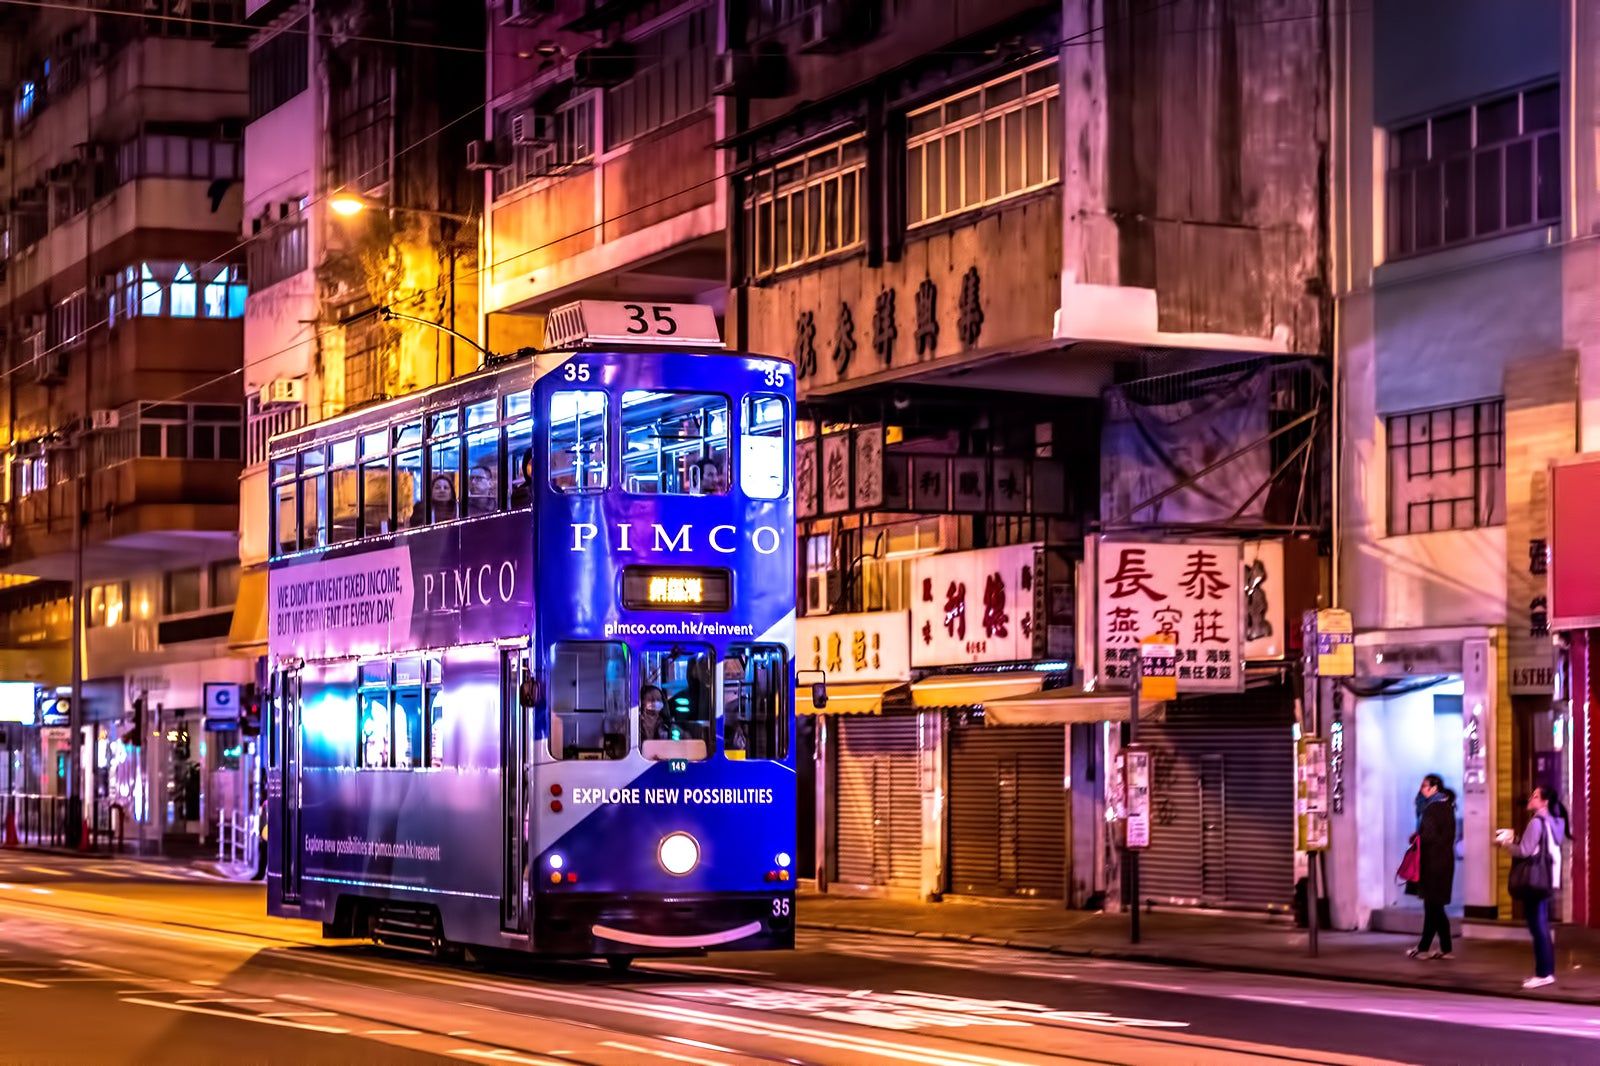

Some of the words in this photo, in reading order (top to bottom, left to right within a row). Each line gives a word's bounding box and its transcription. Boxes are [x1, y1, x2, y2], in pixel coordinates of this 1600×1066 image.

[624, 304, 677, 335] 35
[564, 363, 590, 382] 35
[764, 368, 785, 388] 35
[570, 523, 780, 554] PIMCO
[277, 585, 289, 608] WE
[290, 582, 314, 607] DIDN'T
[315, 577, 342, 603] INVENT
[344, 573, 366, 600] FIXED
[367, 567, 403, 596] INCOME,
[423, 561, 515, 611] PIMCO
[277, 612, 291, 636] BUT
[292, 610, 303, 634] WE
[342, 604, 349, 627] IT
[350, 600, 375, 627] EVERY
[377, 597, 395, 624] DAY.
[604, 621, 753, 637] pimco.com.hk/reinvent
[671, 761, 686, 771] 149
[572, 788, 640, 804] EXPLORE
[645, 788, 679, 804] NEW
[684, 788, 773, 804] POSSIBILITIES
[305, 834, 324, 855] Explore
[325, 839, 336, 853] new
[337, 835, 368, 857] possibilities
[368, 841, 375, 856] at
[772, 898, 790, 916] 35
